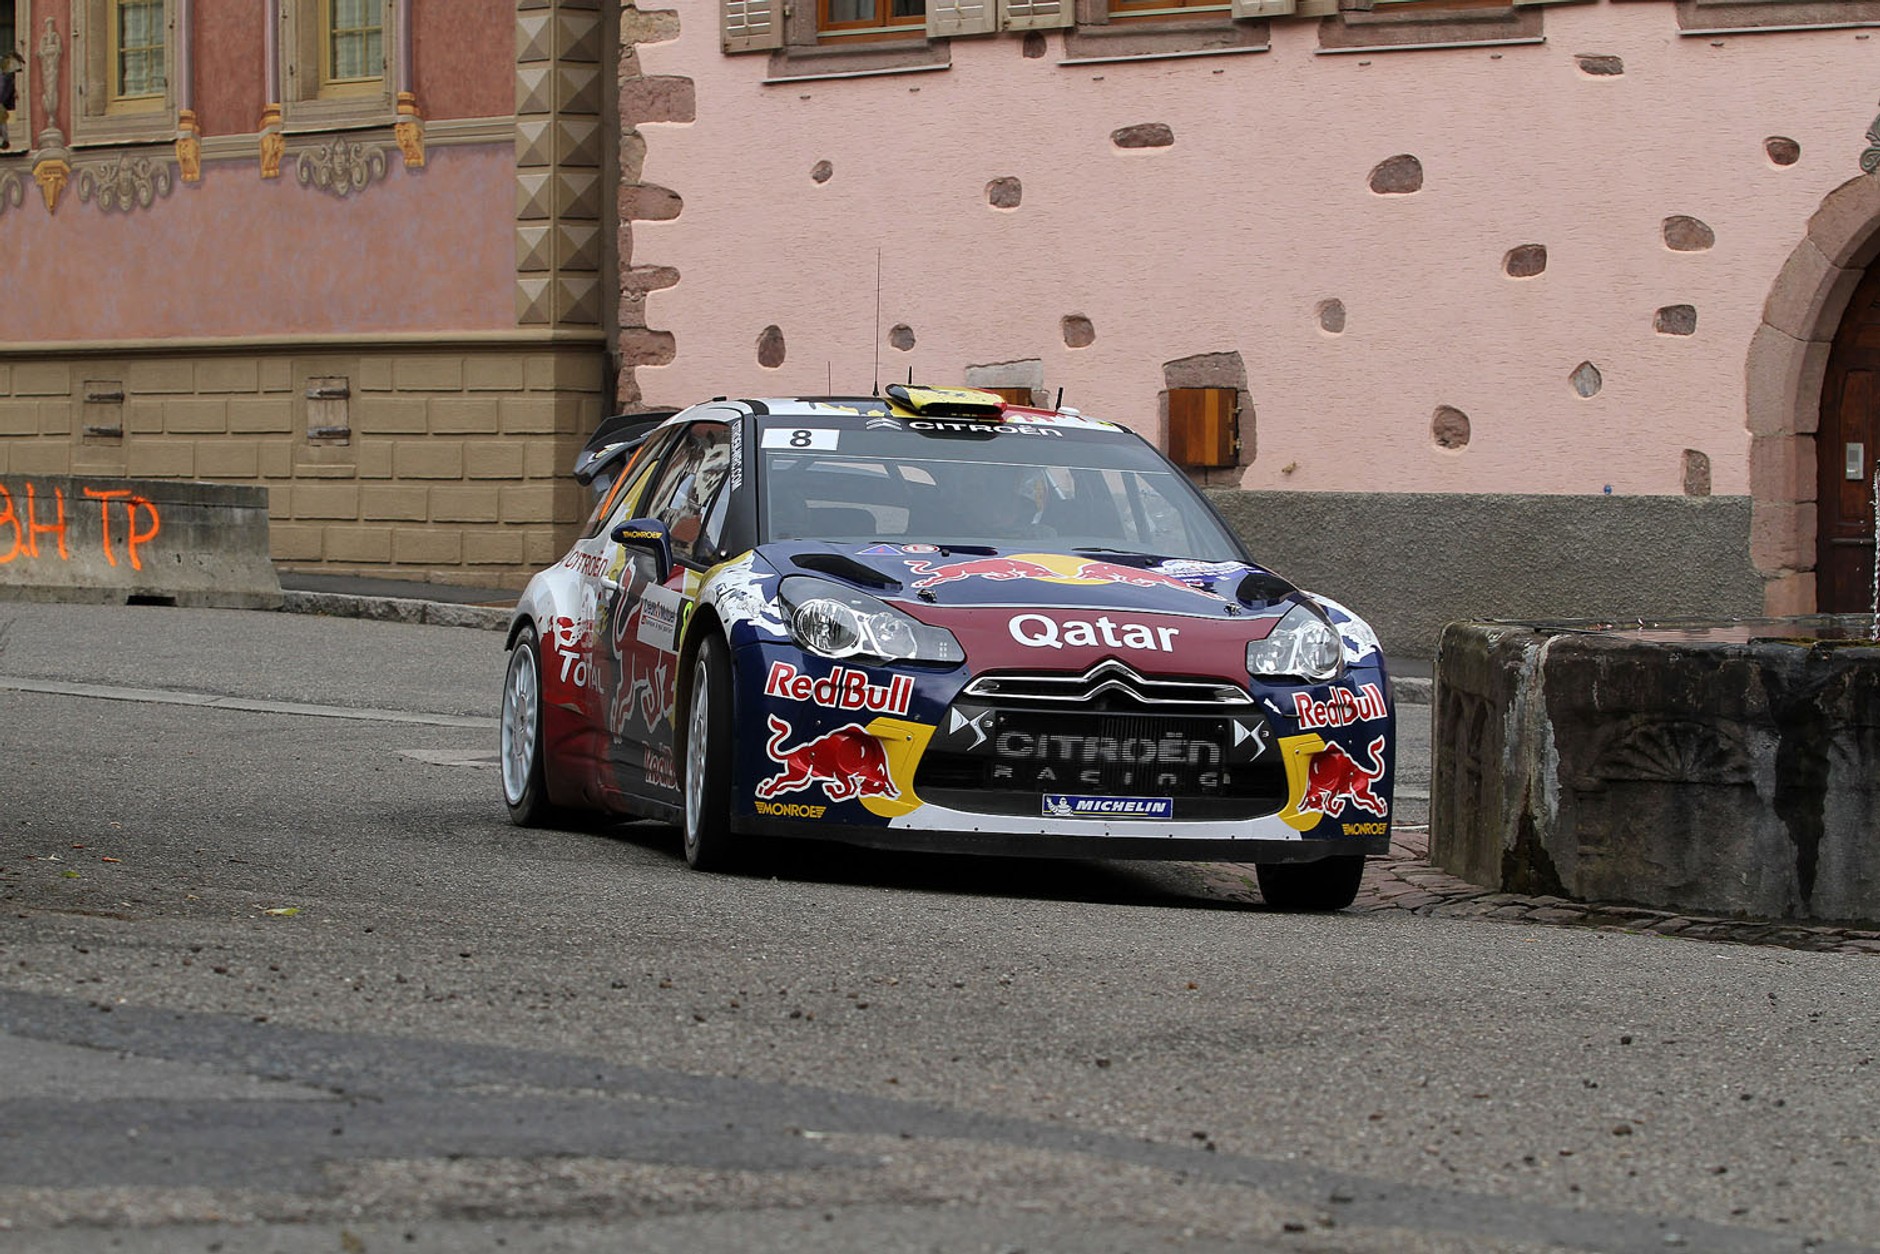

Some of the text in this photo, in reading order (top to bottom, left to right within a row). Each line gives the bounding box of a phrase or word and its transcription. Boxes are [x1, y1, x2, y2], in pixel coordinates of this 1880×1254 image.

[789, 429, 812, 448] 8
[84, 487, 160, 570] TP
[625, 530, 661, 539] MONROE
[1008, 613, 1180, 653] Qatar
[760, 802, 822, 818] MONROE
[1076, 799, 1167, 813] MICHELIN
[1345, 823, 1385, 835] MONROE
